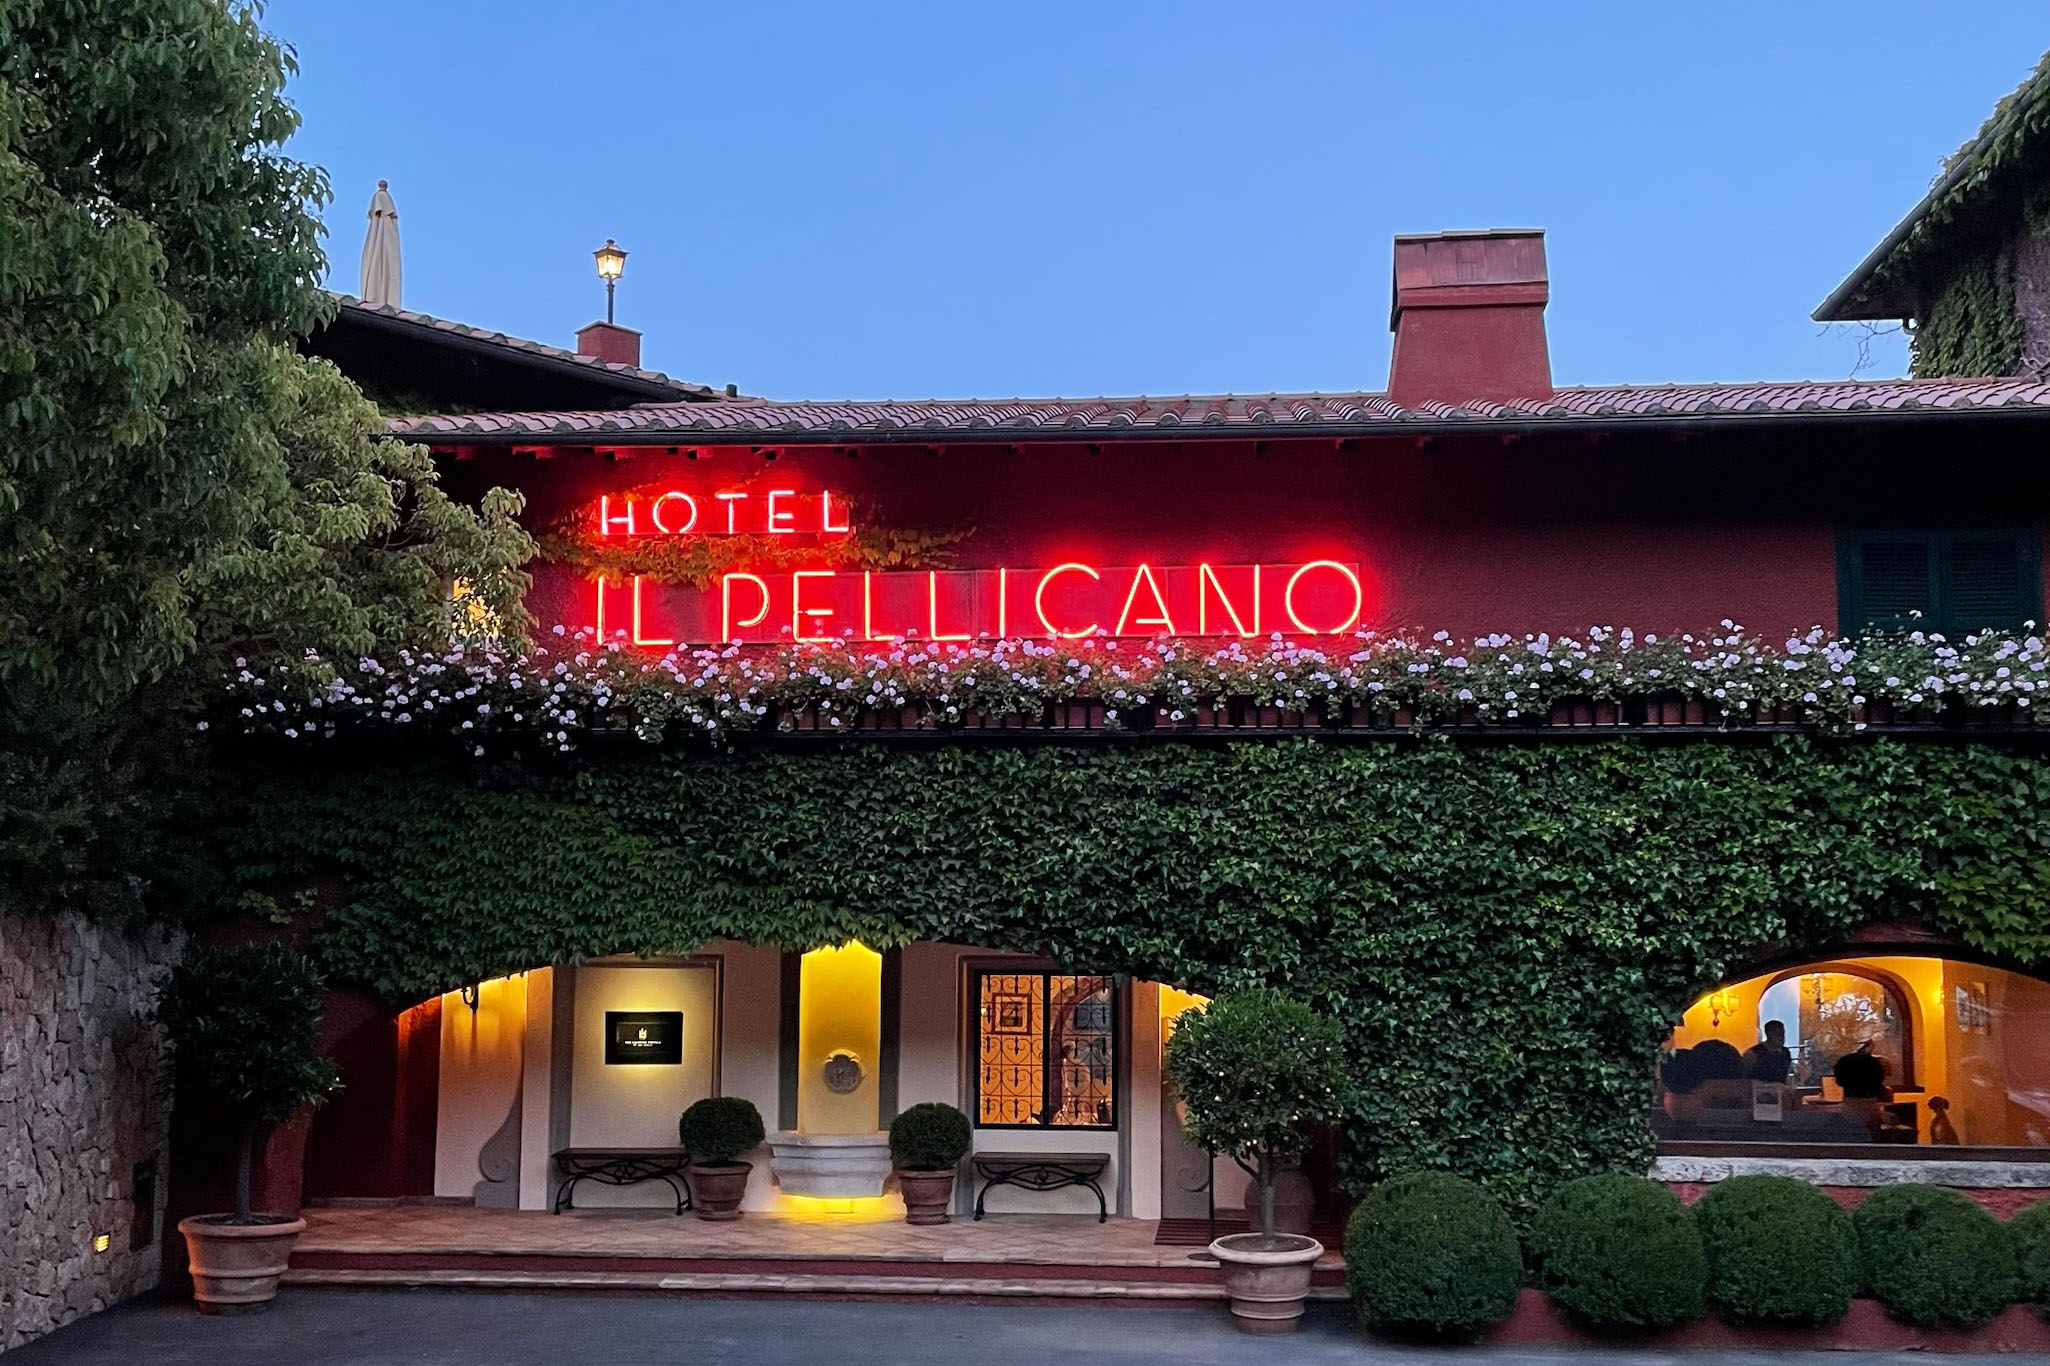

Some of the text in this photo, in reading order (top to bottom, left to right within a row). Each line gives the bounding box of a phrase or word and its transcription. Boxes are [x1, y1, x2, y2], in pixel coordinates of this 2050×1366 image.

[600, 489, 849, 536] HOTEL
[597, 560, 1362, 646] IL PELLICANO
